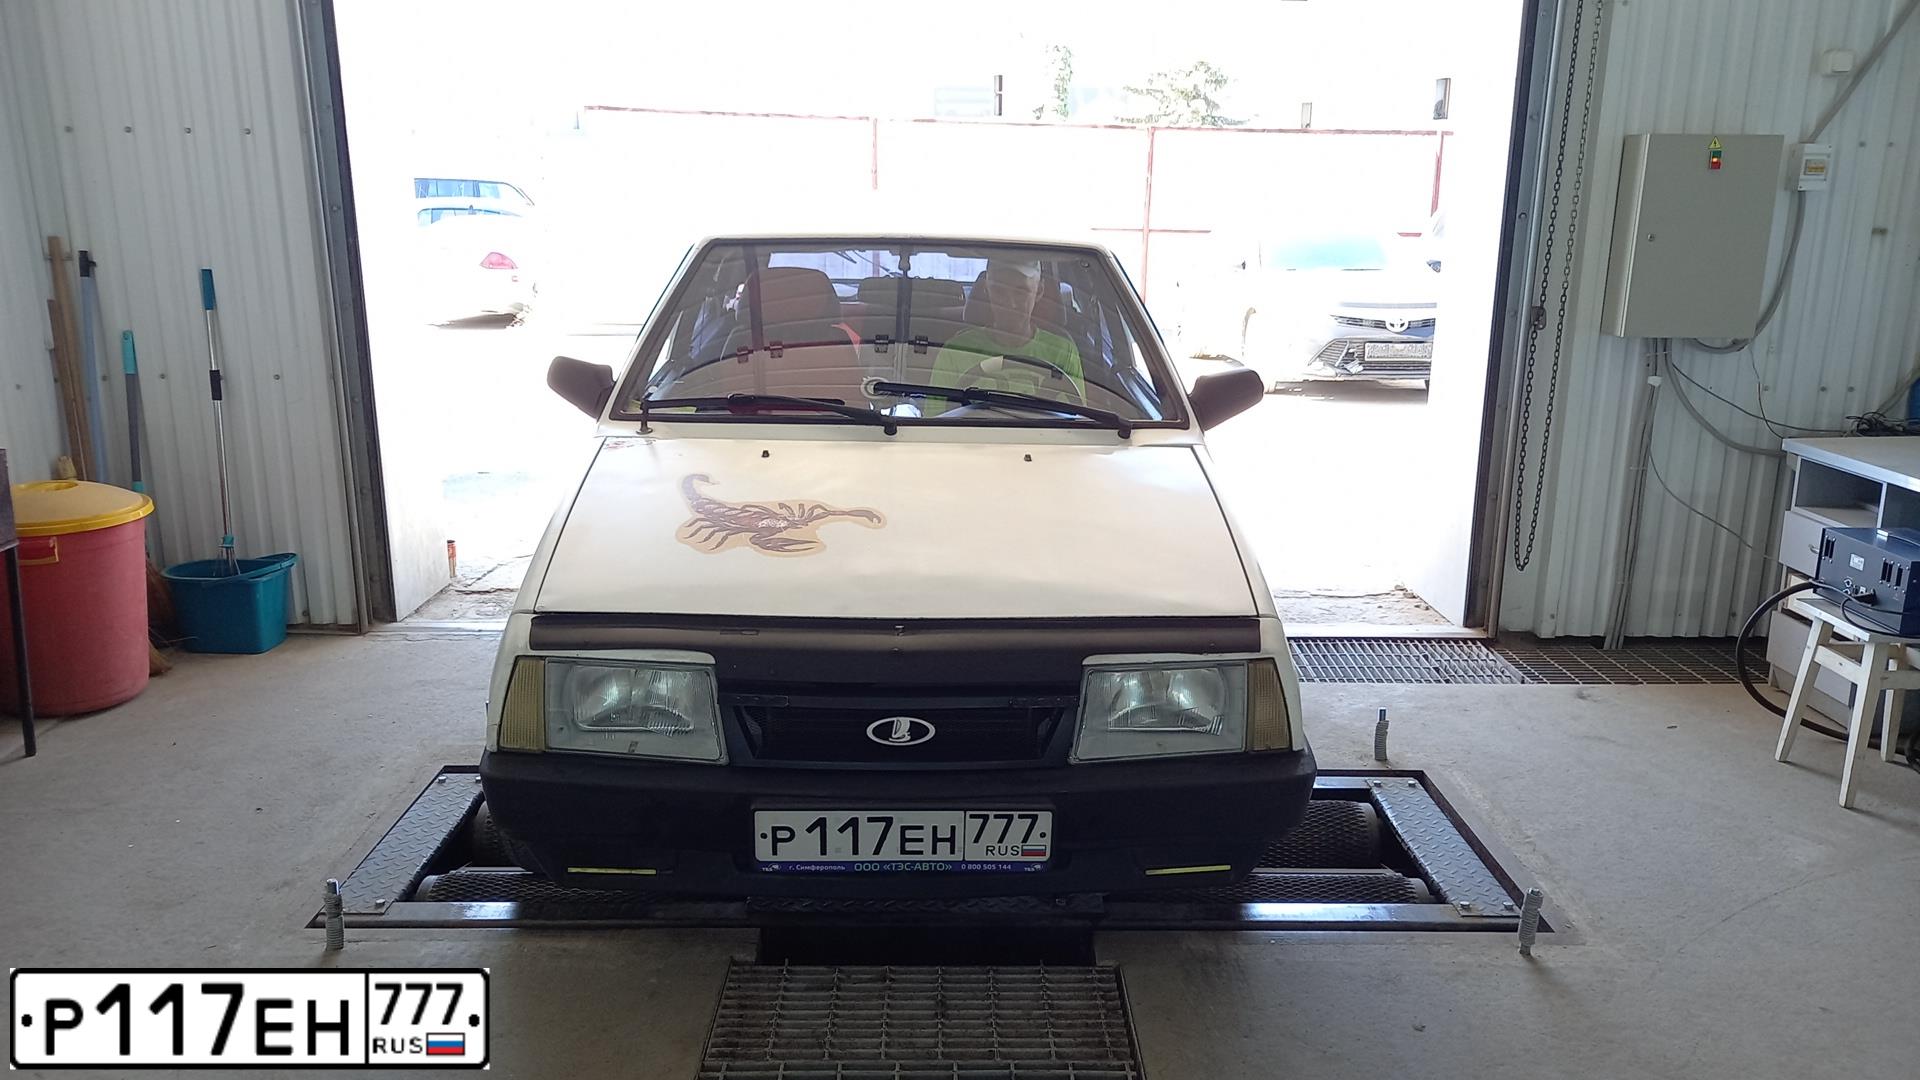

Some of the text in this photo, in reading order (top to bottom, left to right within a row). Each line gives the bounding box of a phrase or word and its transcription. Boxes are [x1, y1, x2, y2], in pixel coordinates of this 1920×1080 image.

[968, 813, 1039, 844] 777
[770, 816, 957, 856] Р117ЕН
[985, 845, 1020, 857] RUS
[796, 864, 846, 872] Симферополь
[854, 862, 953, 871] ООО «ТЭС-АВТО»
